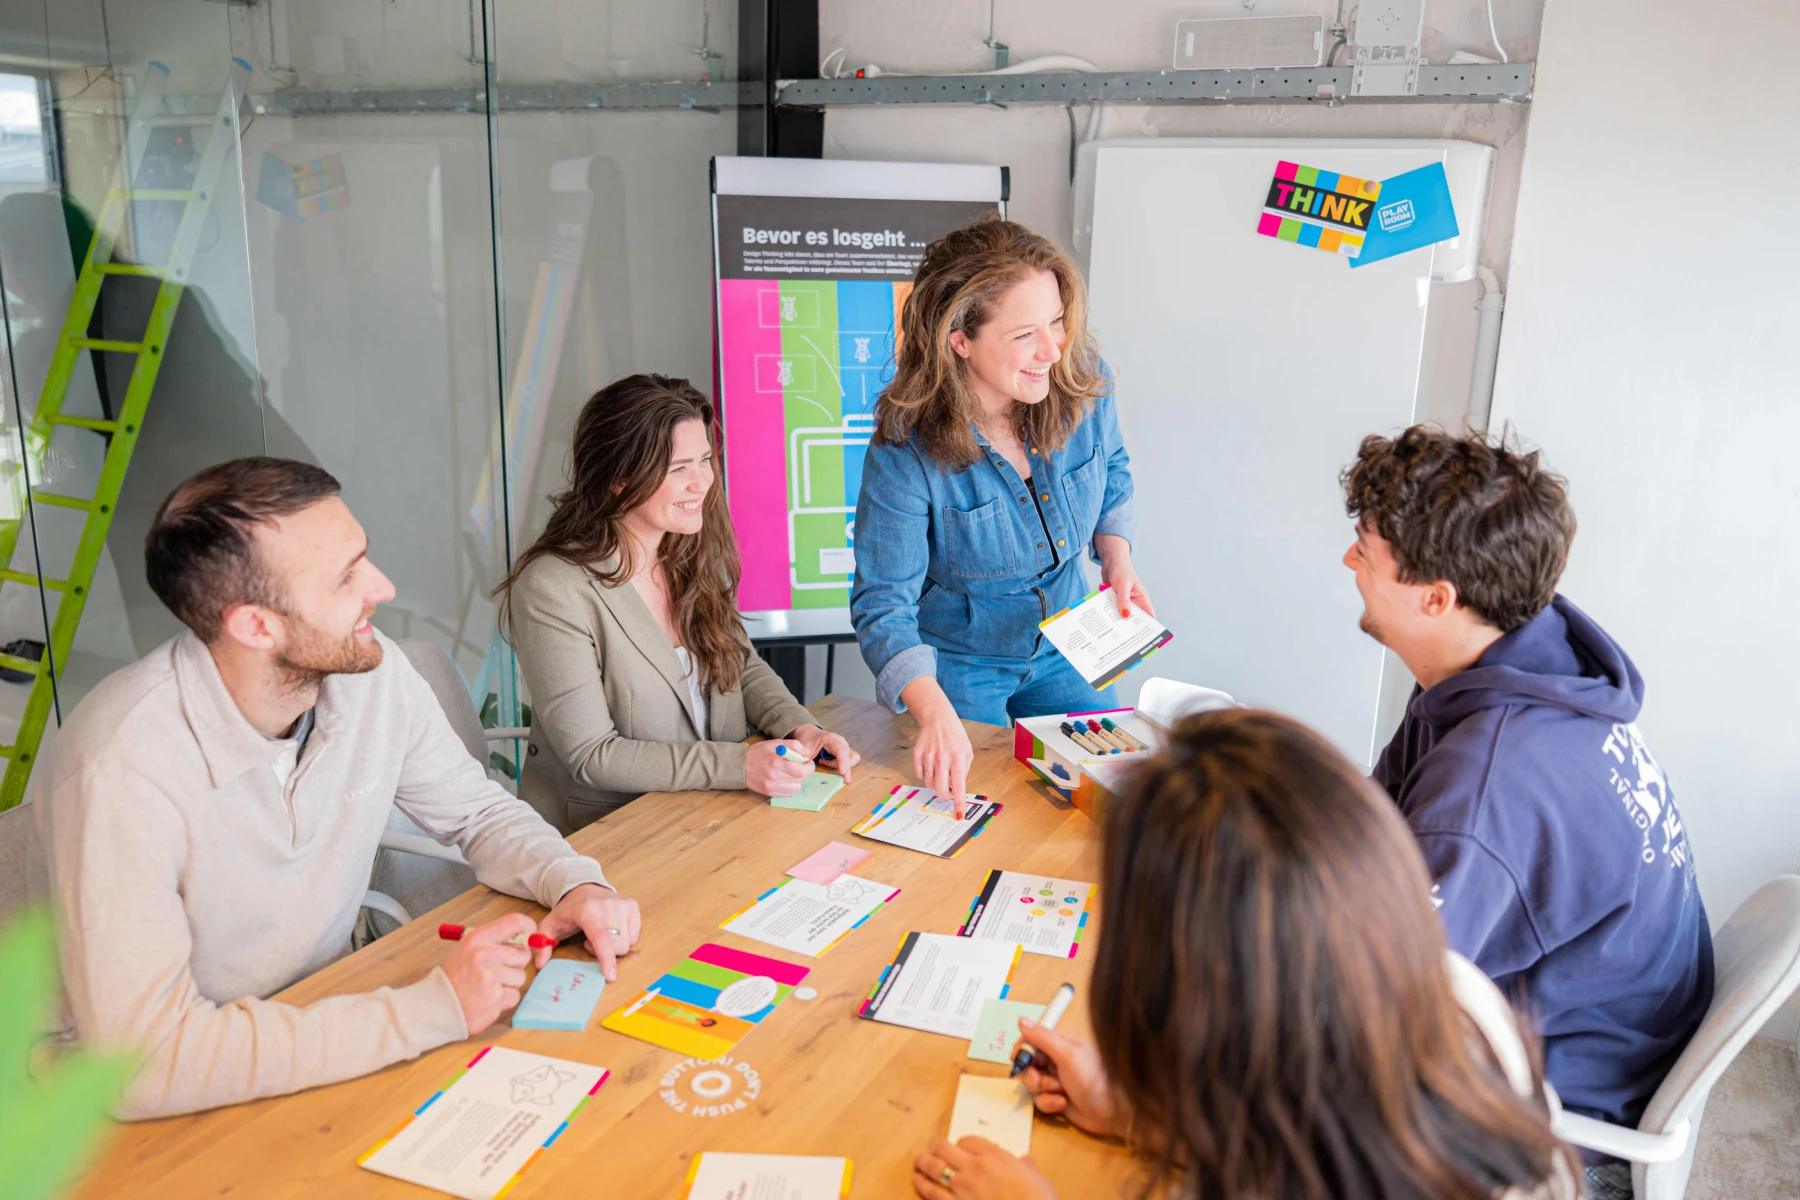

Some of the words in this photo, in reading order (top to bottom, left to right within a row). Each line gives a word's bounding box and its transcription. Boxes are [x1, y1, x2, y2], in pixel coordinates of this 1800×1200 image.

[1276, 183, 1369, 227] THINK
[1382, 203, 1409, 219] PLAY
[1384, 211, 1412, 226] ROOM
[743, 227, 801, 245] Bevor
[805, 231, 829, 246] es
[833, 228, 906, 250] losgeht
[1609, 767, 1656, 864] OGINAL
[735, 1061, 761, 1101] DON'T
[659, 1088, 689, 1114] THE
[691, 1097, 748, 1118] PUSH
